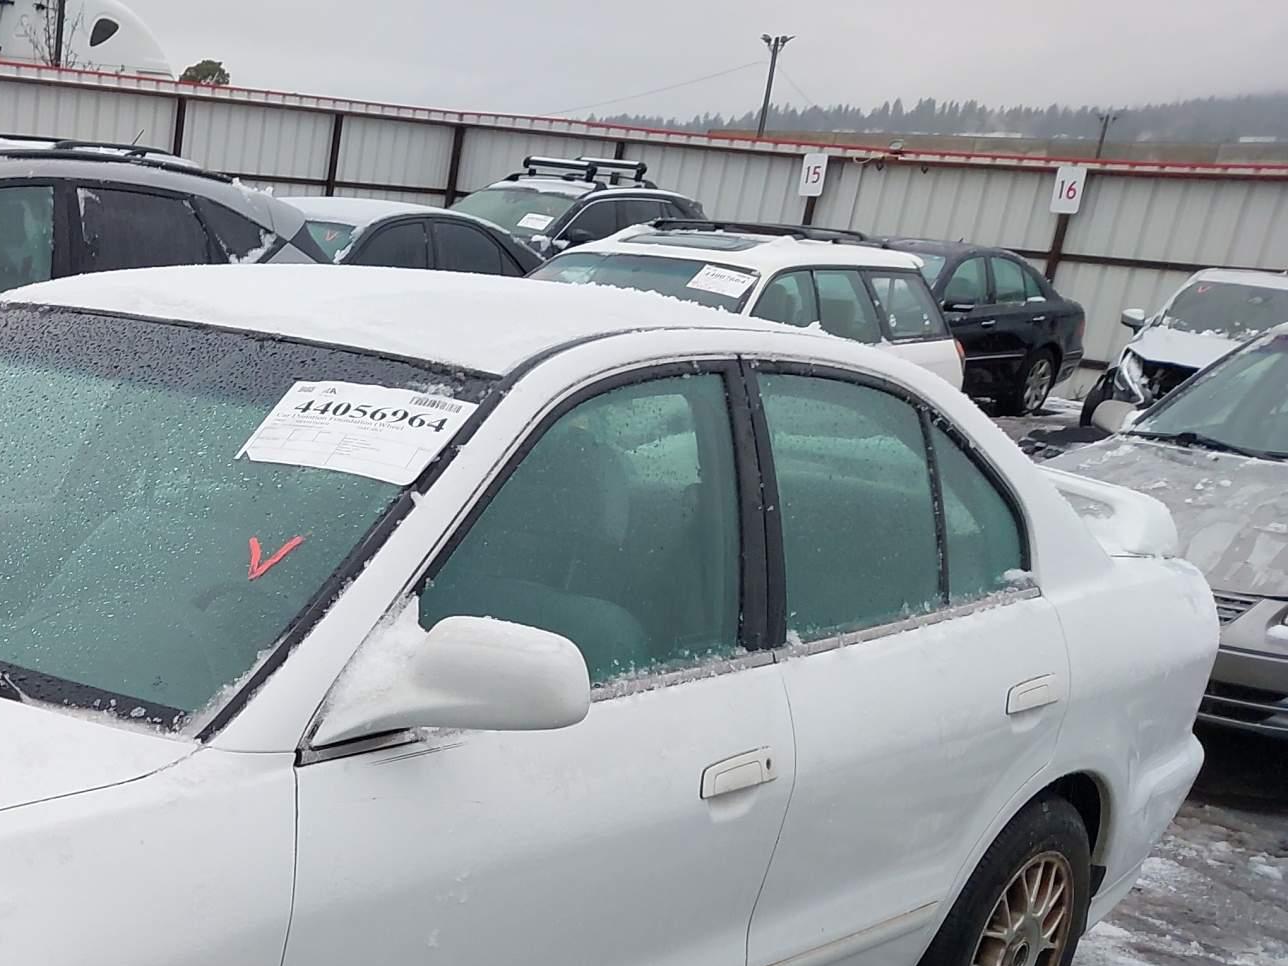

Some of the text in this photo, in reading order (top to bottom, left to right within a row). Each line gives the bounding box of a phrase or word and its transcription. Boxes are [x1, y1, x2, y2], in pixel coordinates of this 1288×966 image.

[805, 165, 822, 184] 15
[1058, 179, 1077, 200] 16
[294, 399, 448, 433] 44056964
